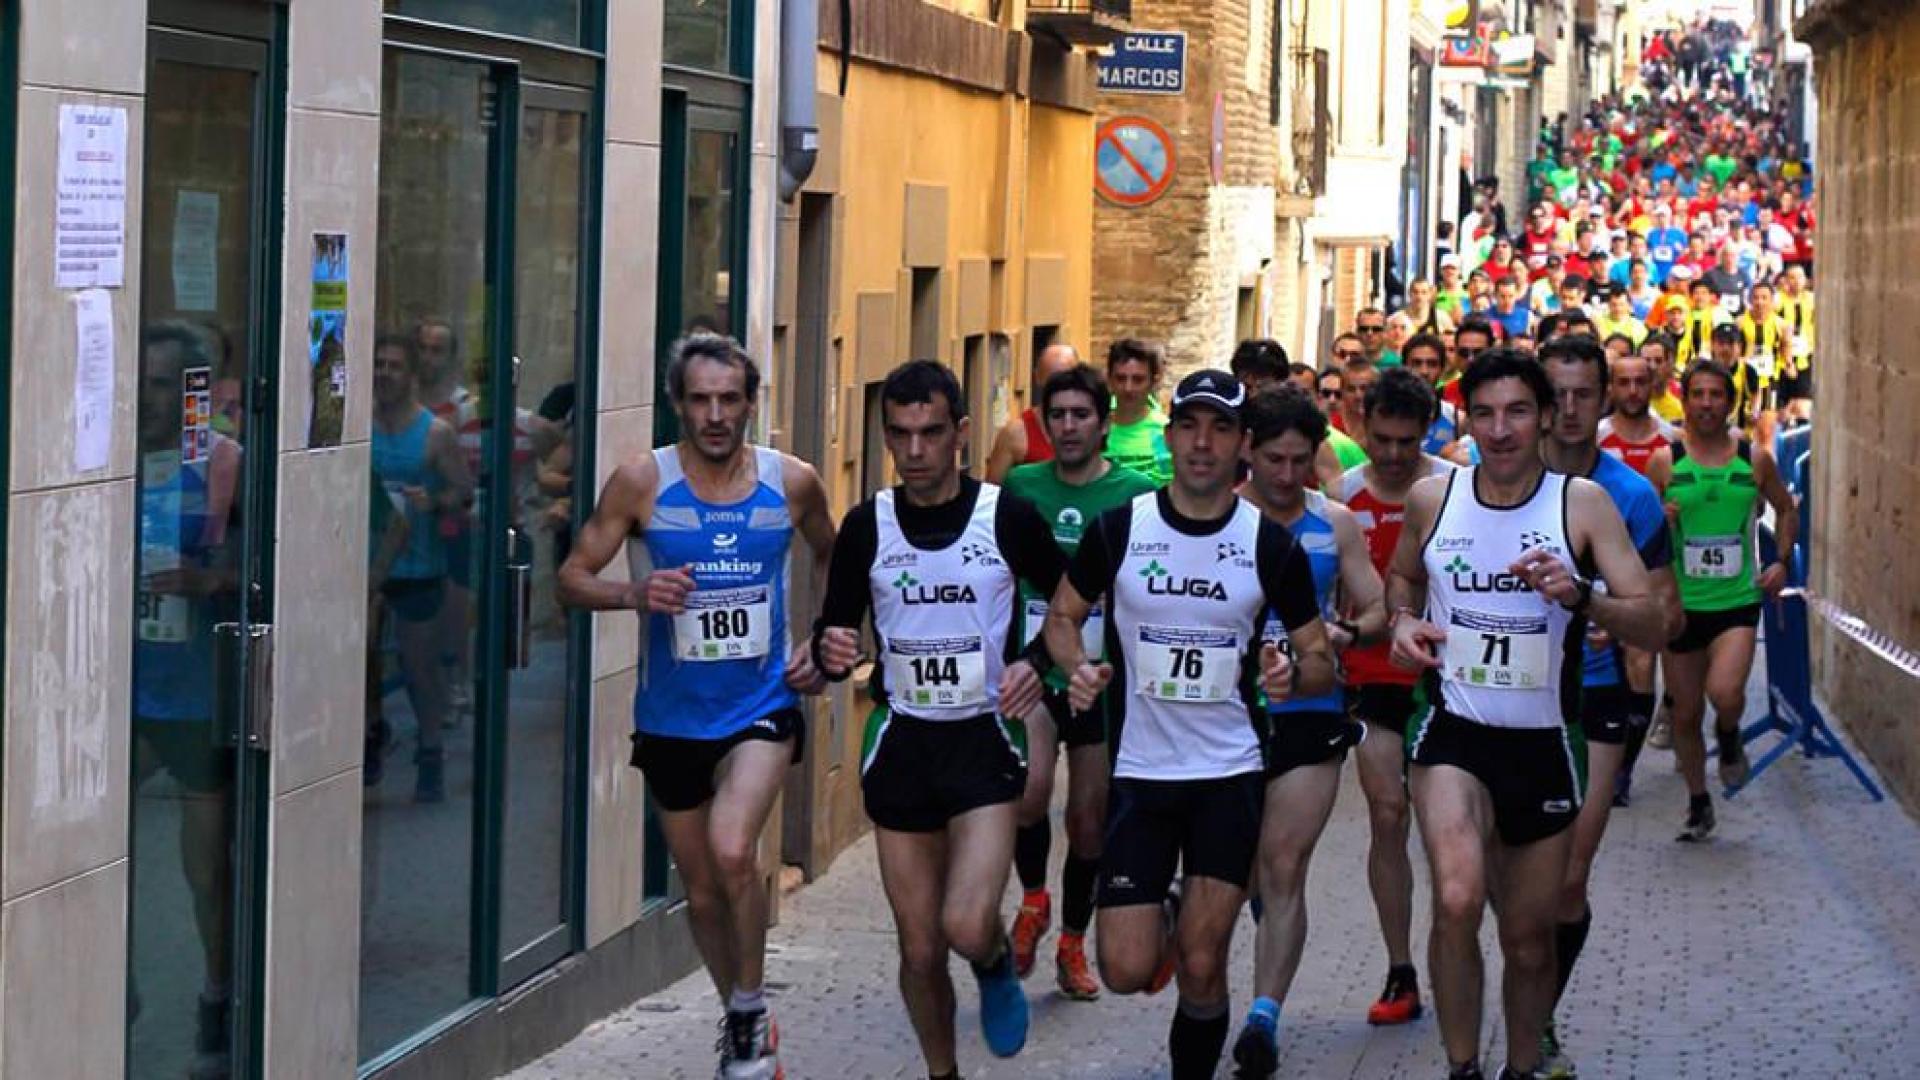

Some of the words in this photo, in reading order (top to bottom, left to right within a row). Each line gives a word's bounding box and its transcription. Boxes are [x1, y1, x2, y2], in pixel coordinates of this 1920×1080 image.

[1124, 37, 1176, 53] CALLE
[1096, 67, 1180, 88] MARCOS
[689, 558, 762, 575] anking
[1701, 548, 1726, 567] 45
[902, 584, 977, 605] LUGA
[1147, 576, 1228, 601] LUGA
[697, 608, 749, 640] 180
[1480, 633, 1510, 666] 71
[909, 656, 960, 686] 144
[1169, 648, 1204, 679] 76
